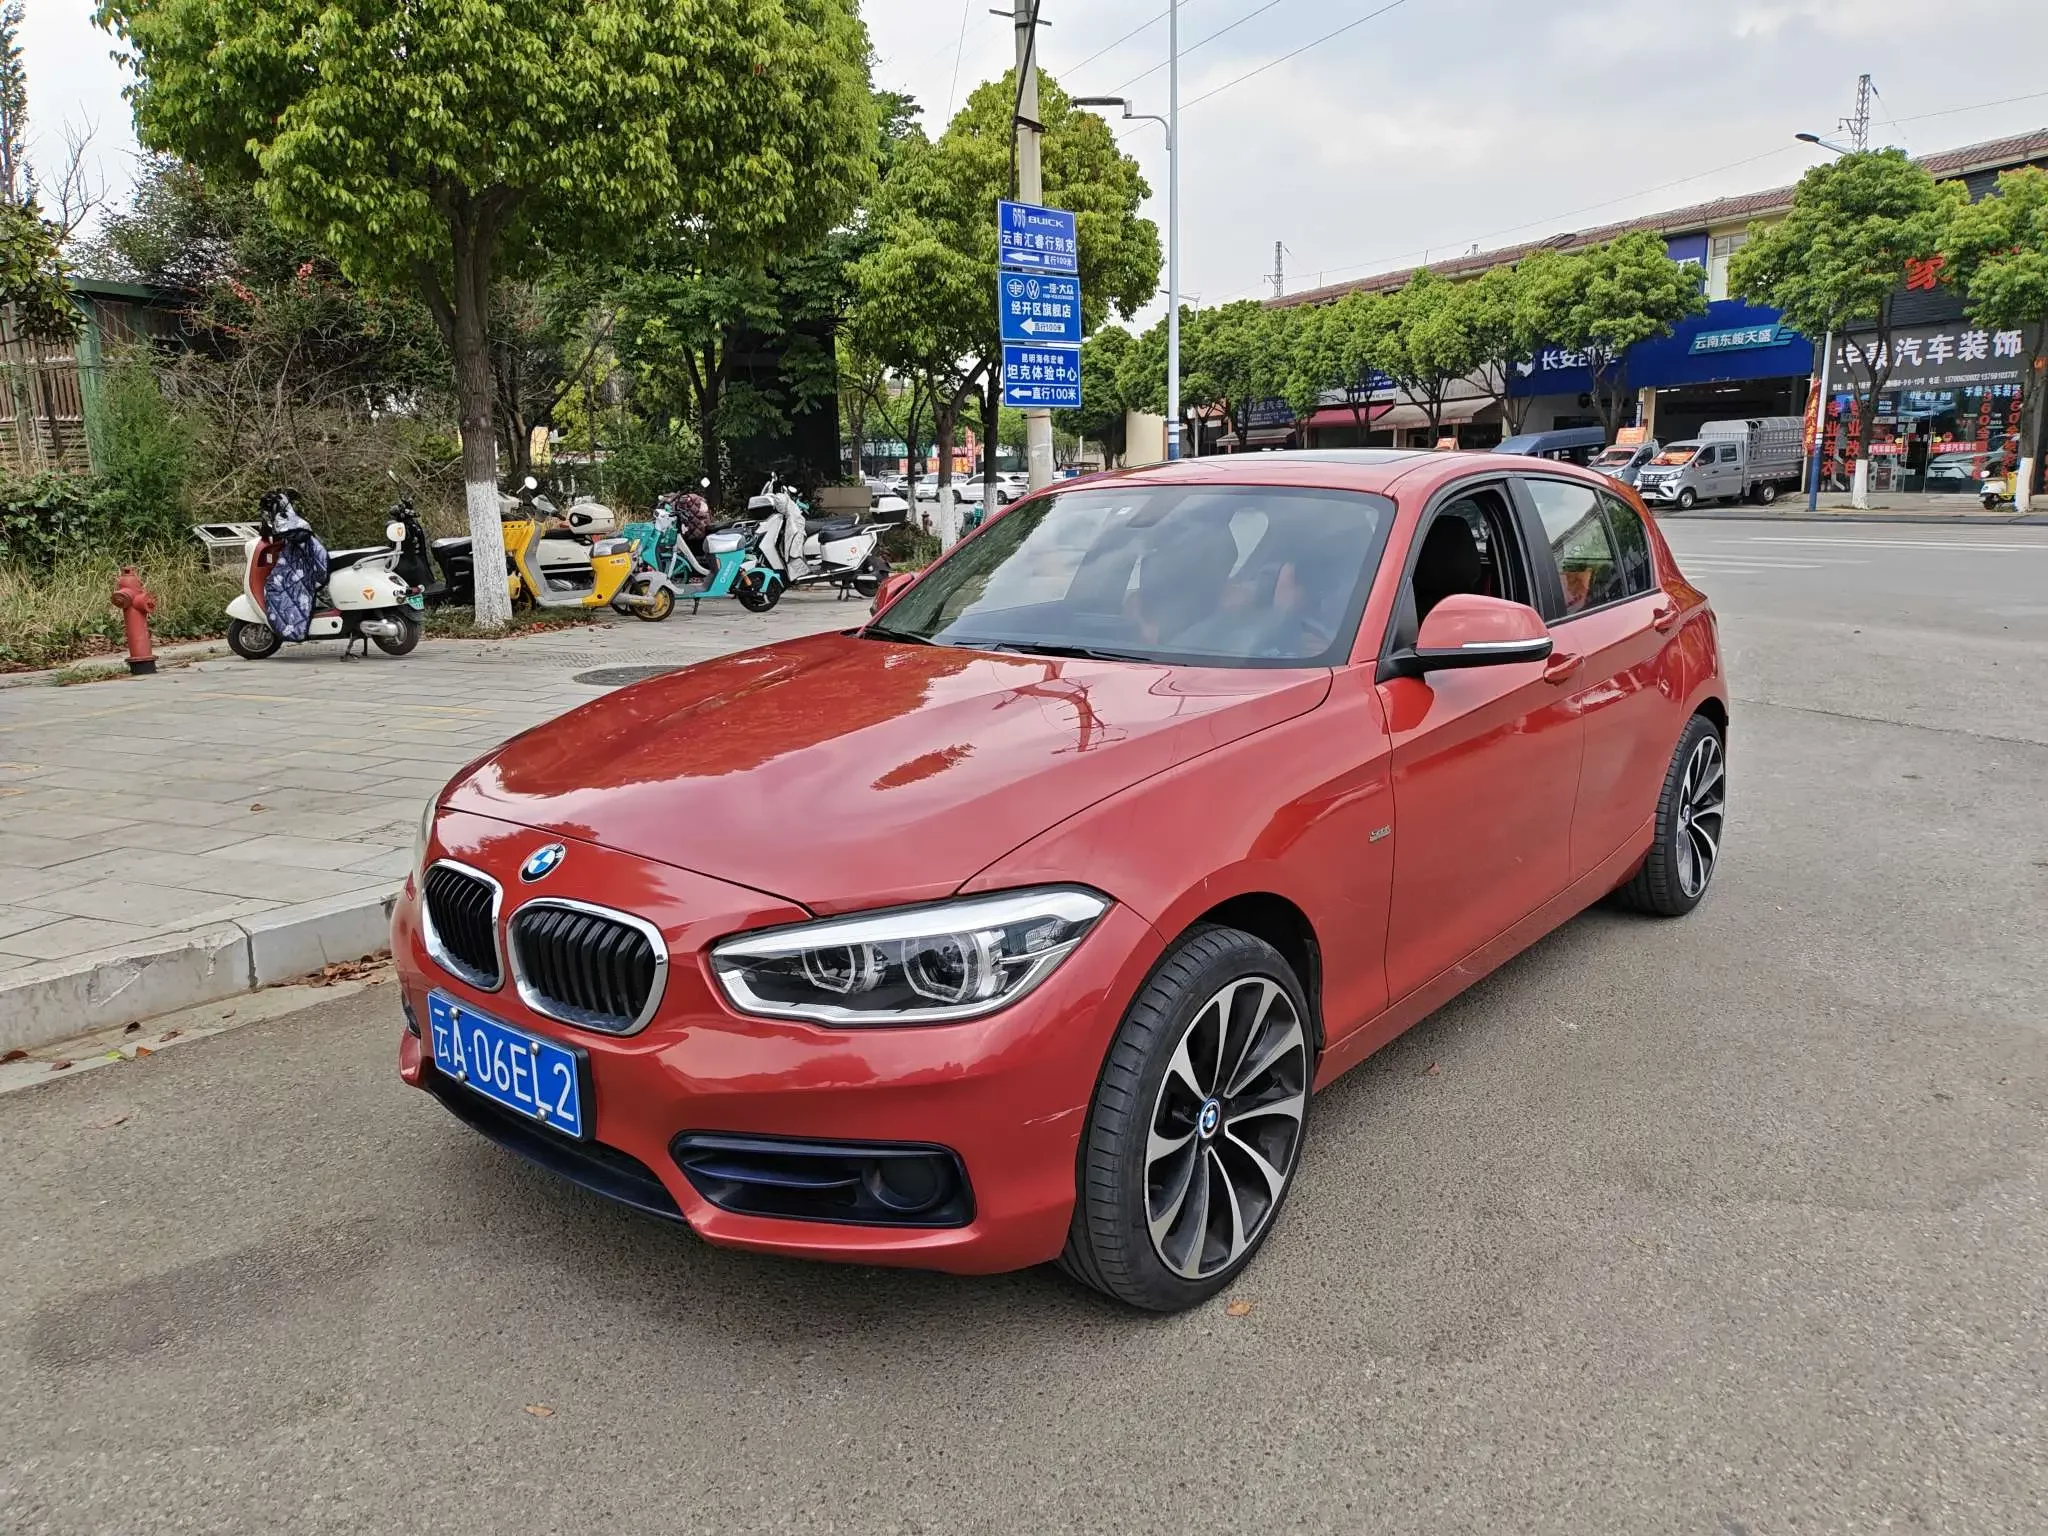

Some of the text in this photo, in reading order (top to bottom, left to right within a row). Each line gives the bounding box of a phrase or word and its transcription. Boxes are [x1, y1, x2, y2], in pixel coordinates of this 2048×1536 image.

[1028, 216, 1064, 228] BUICK
[1011, 300, 1072, 318] 经开区旗舰店
[1695, 328, 1772, 349] 云南东峻天盛
[1007, 364, 1078, 382] 坦克体验中心
[1032, 387, 1077, 400] 直行100米
